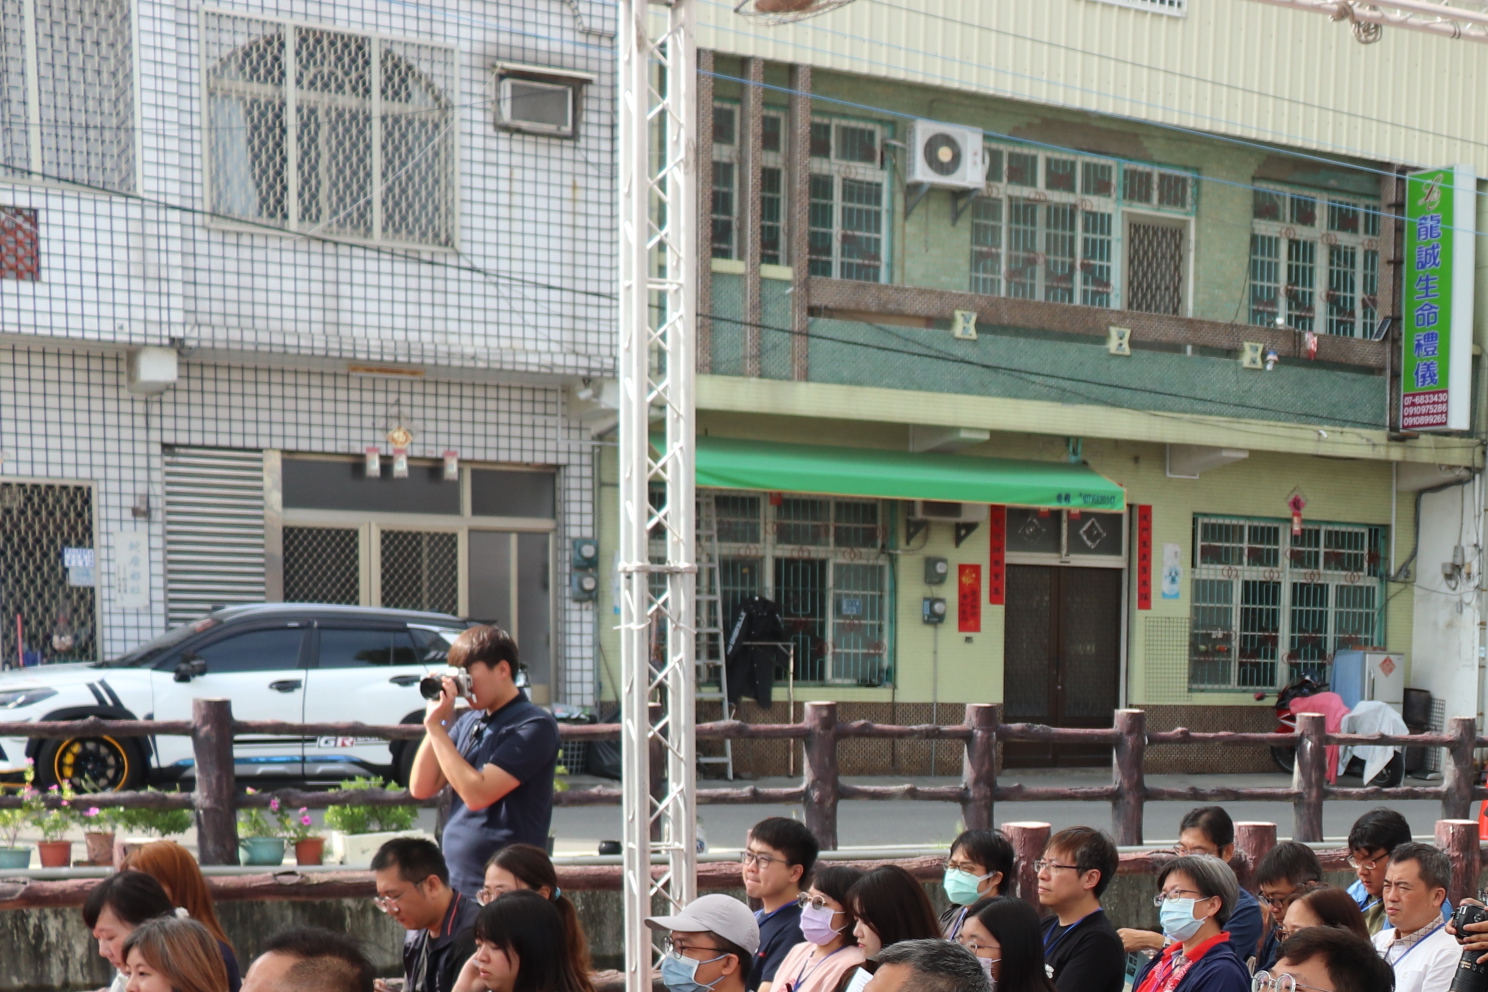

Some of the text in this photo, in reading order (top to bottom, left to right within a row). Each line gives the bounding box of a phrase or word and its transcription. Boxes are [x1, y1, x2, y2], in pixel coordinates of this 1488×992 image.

[1413, 213, 1443, 389] 龍誠生命禮儀
[1403, 393, 1448, 406] 07-6833430
[1403, 403, 1447, 416] 0910975286
[1403, 413, 1447, 427] 0910899265
